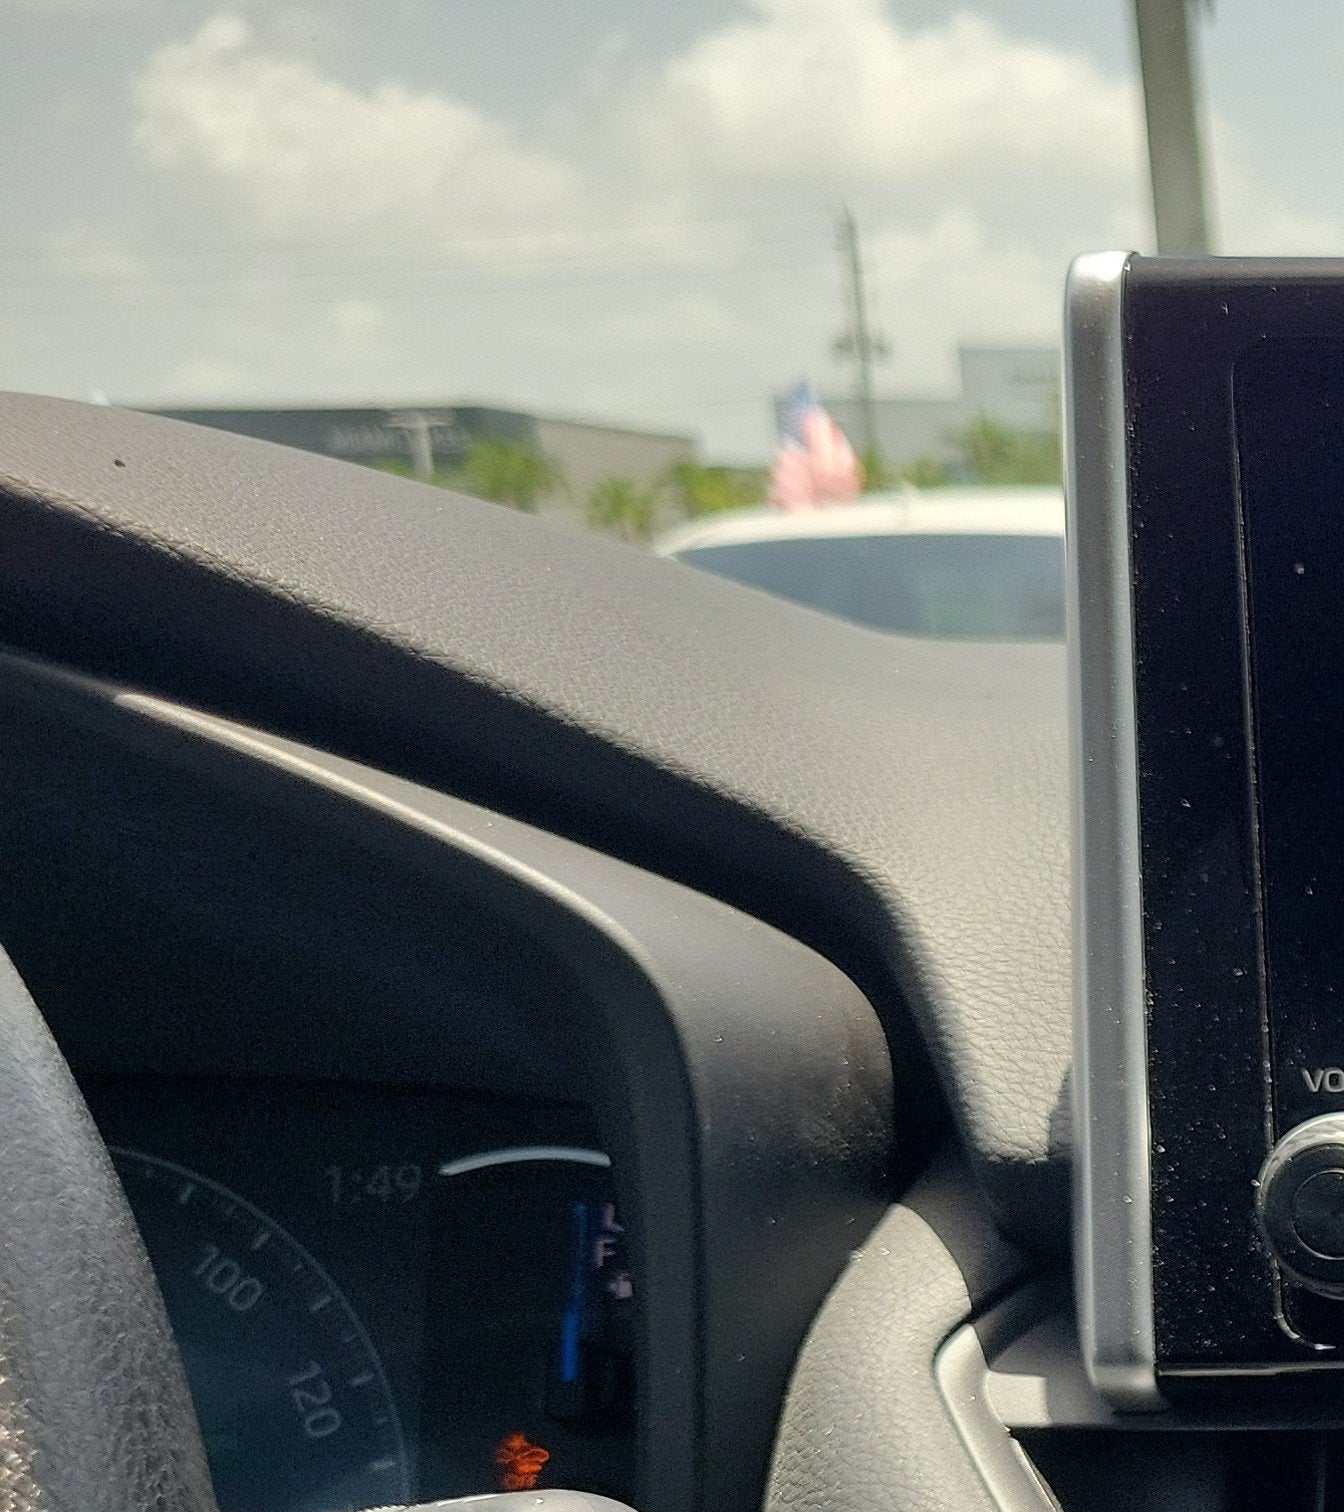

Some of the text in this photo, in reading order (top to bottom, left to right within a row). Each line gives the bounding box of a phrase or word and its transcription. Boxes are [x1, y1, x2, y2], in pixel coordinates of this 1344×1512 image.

[325, 1165, 422, 1204] 1:49
[191, 1245, 266, 1312] 100
[287, 1360, 344, 1439] 120
